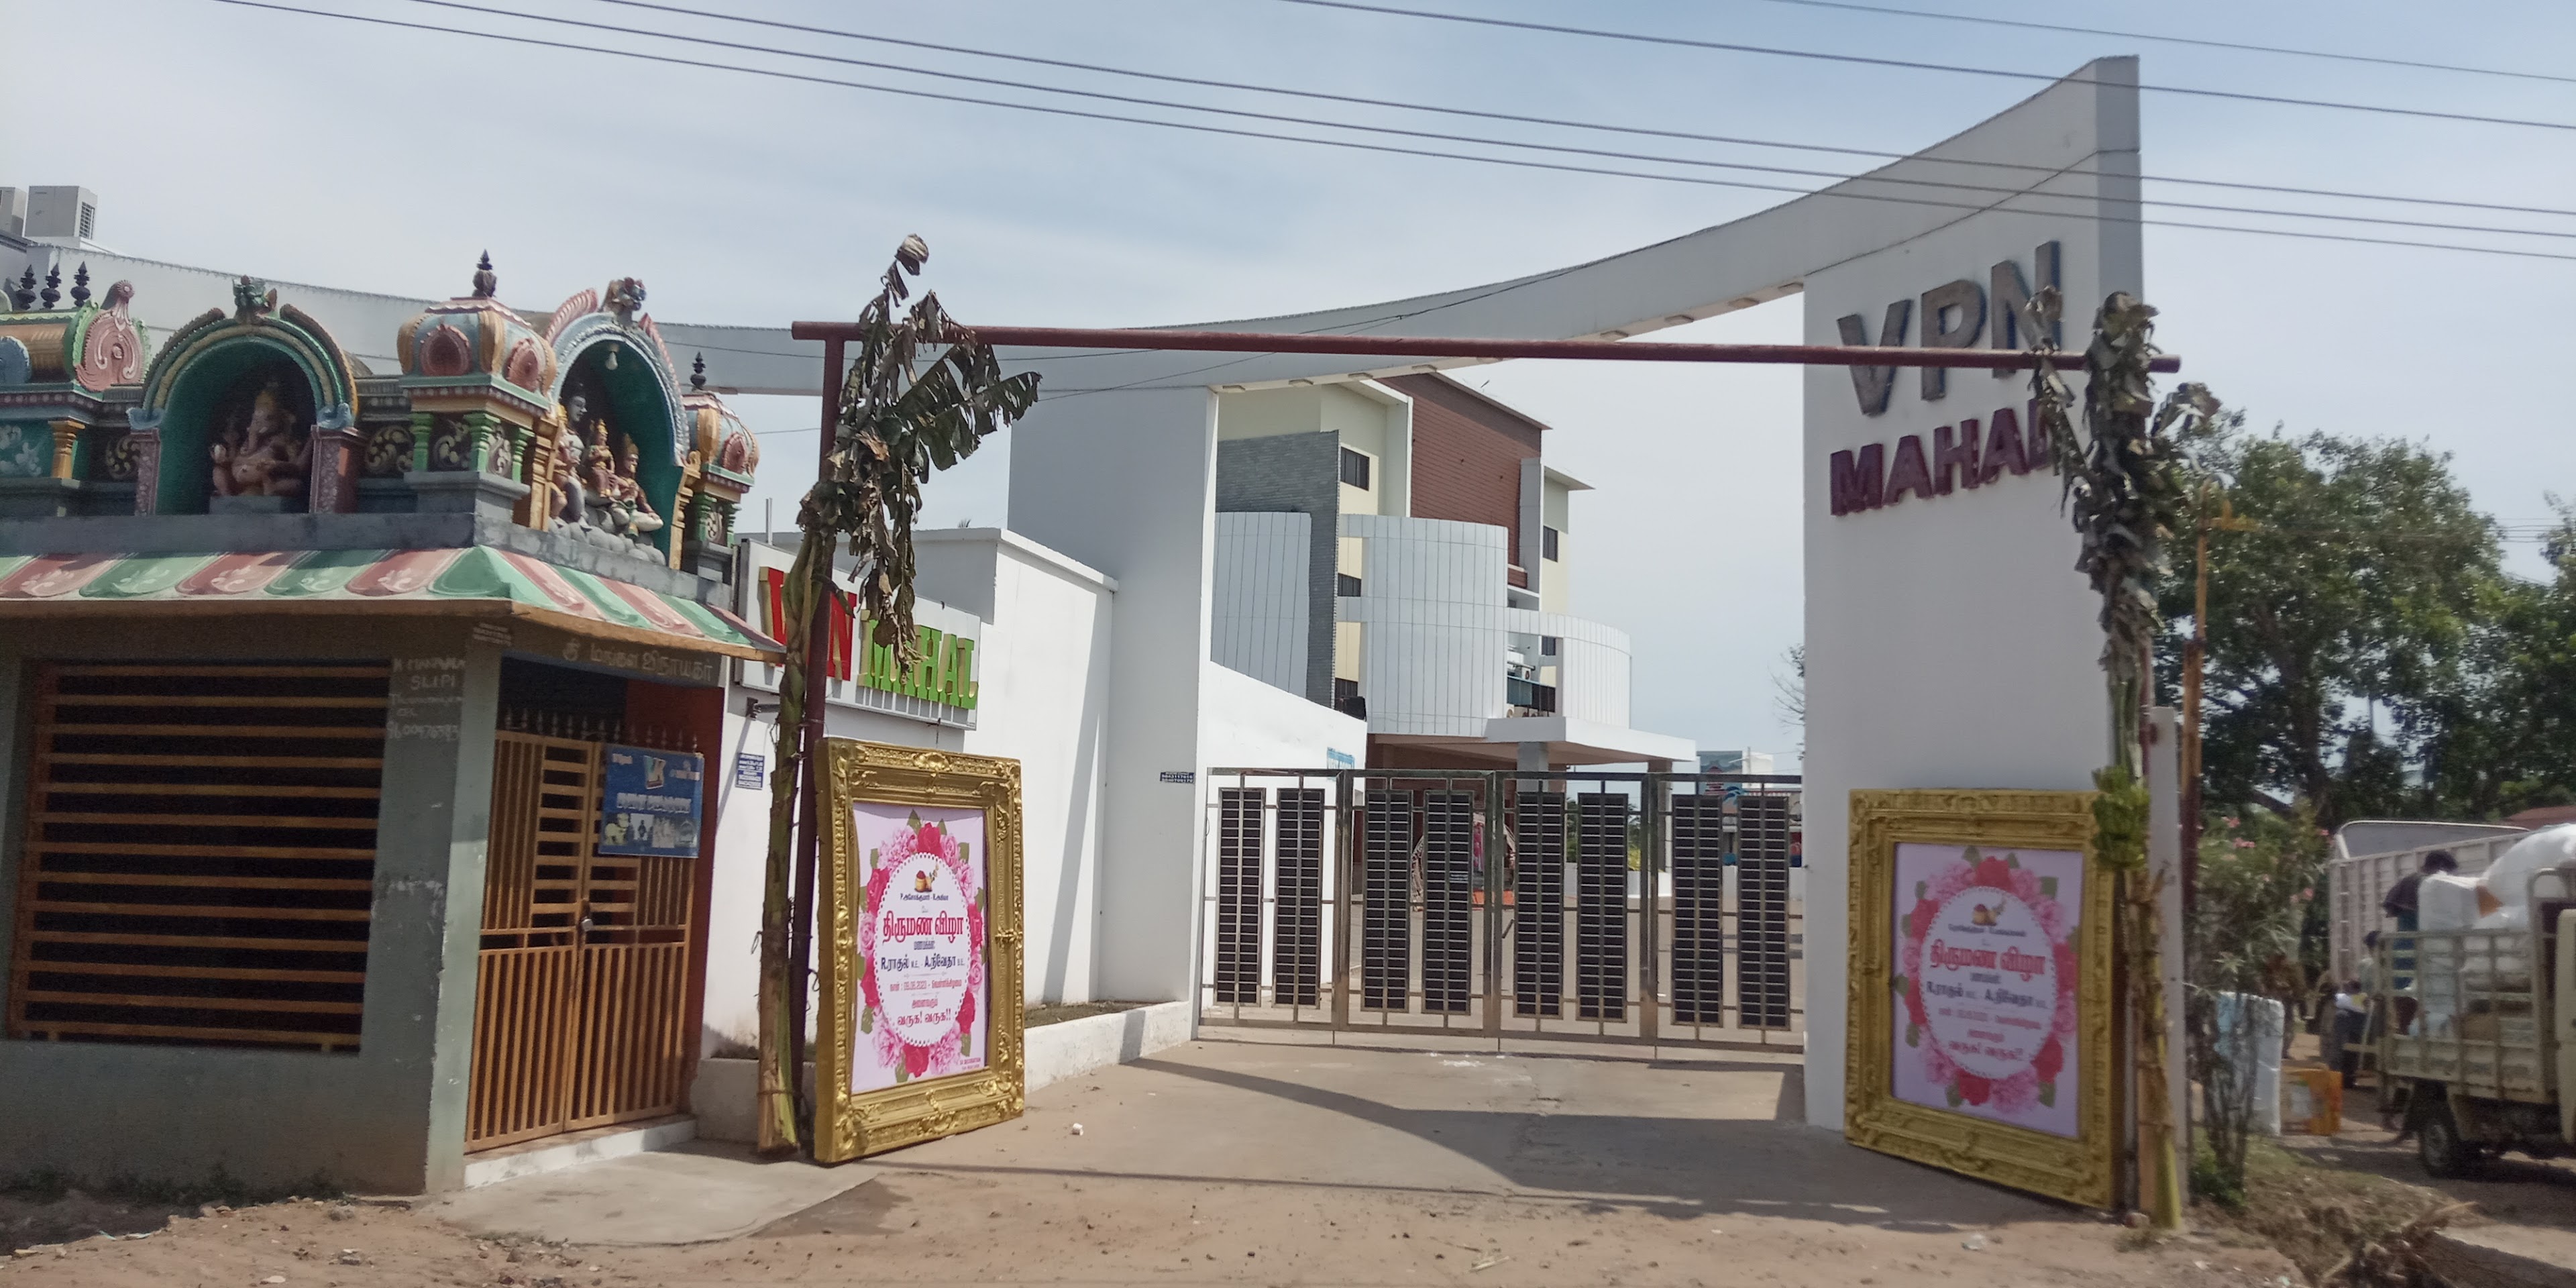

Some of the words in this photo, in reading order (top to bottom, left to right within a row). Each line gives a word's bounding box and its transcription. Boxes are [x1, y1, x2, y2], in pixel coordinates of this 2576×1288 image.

[1836, 241, 2062, 417] VPN
[759, 566, 857, 682] VN
[883, 910, 932, 944] திருமண
[934, 910, 963, 943] விழா
[898, 1011, 922, 1027] வருக!
[925, 1008, 951, 1024] வருக!!
